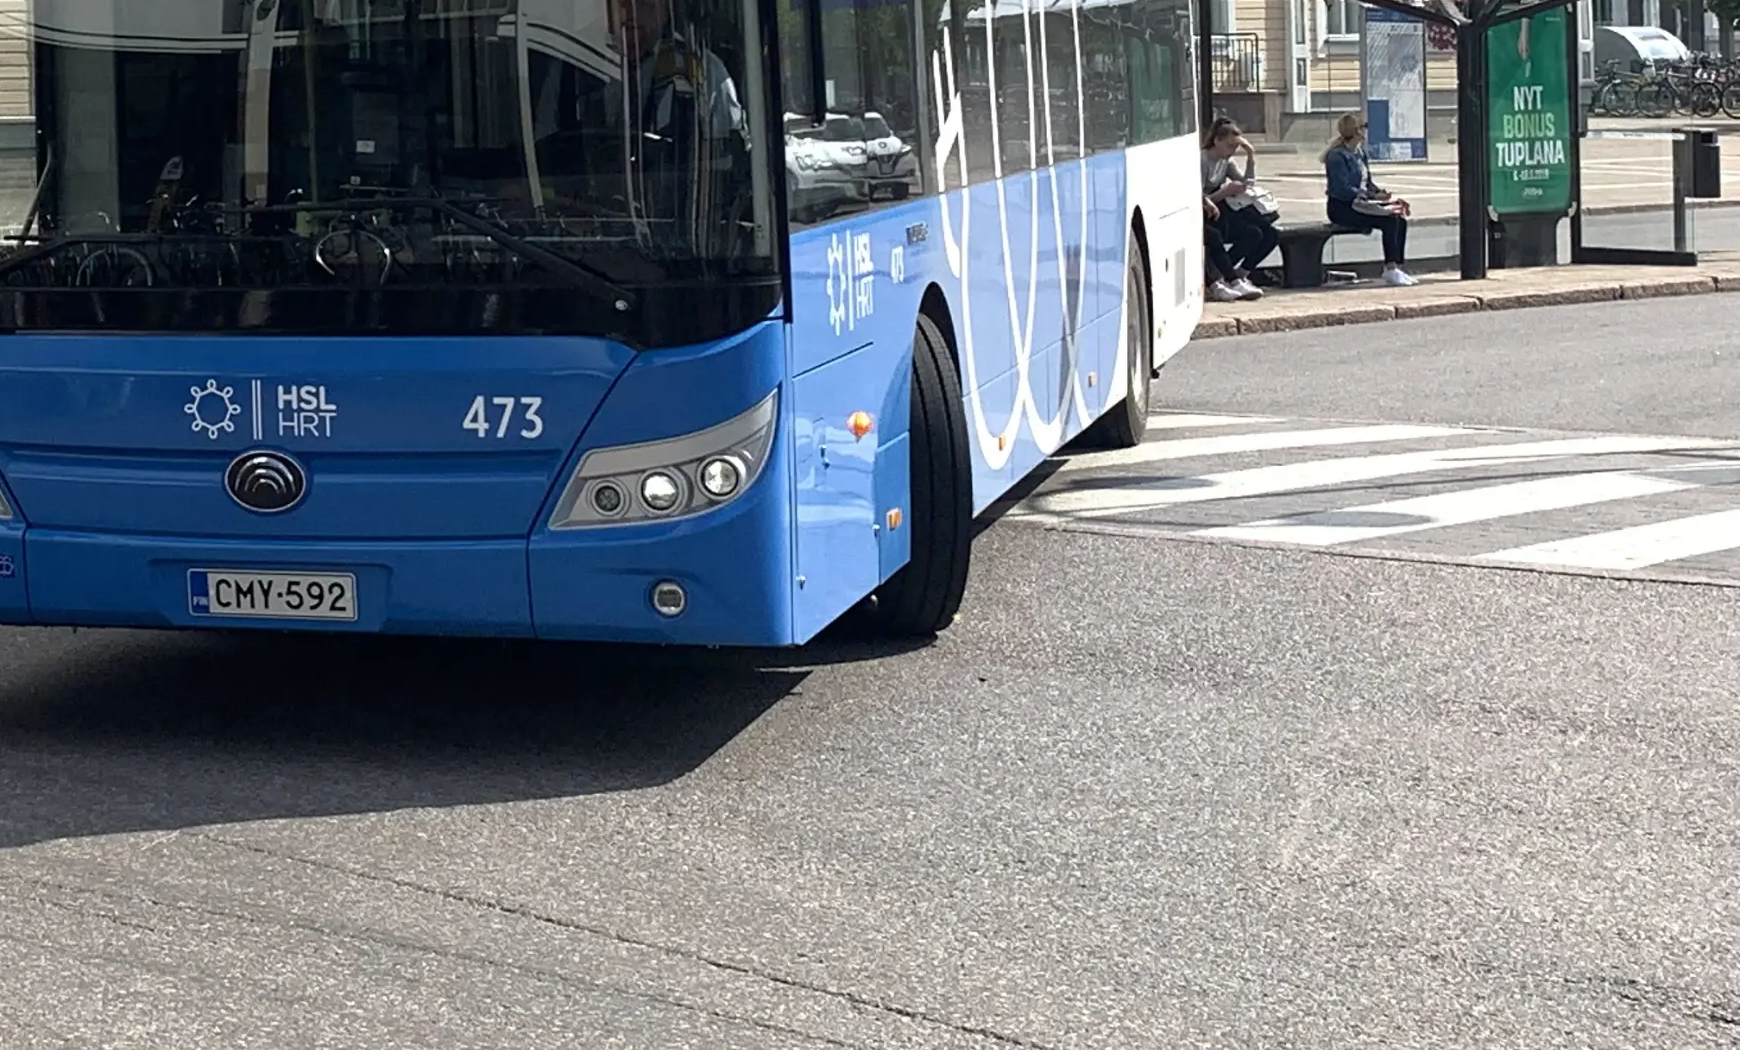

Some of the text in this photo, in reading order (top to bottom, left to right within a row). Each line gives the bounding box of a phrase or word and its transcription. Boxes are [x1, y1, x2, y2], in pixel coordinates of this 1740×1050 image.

[1513, 86, 1543, 111] NYT
[1503, 112, 1555, 138] BONUS
[1495, 139, 1565, 167] TUPLANA
[277, 385, 337, 411] HSL
[278, 412, 337, 438] HRT
[462, 395, 544, 439] 473
[214, 578, 347, 613] CMY-592
